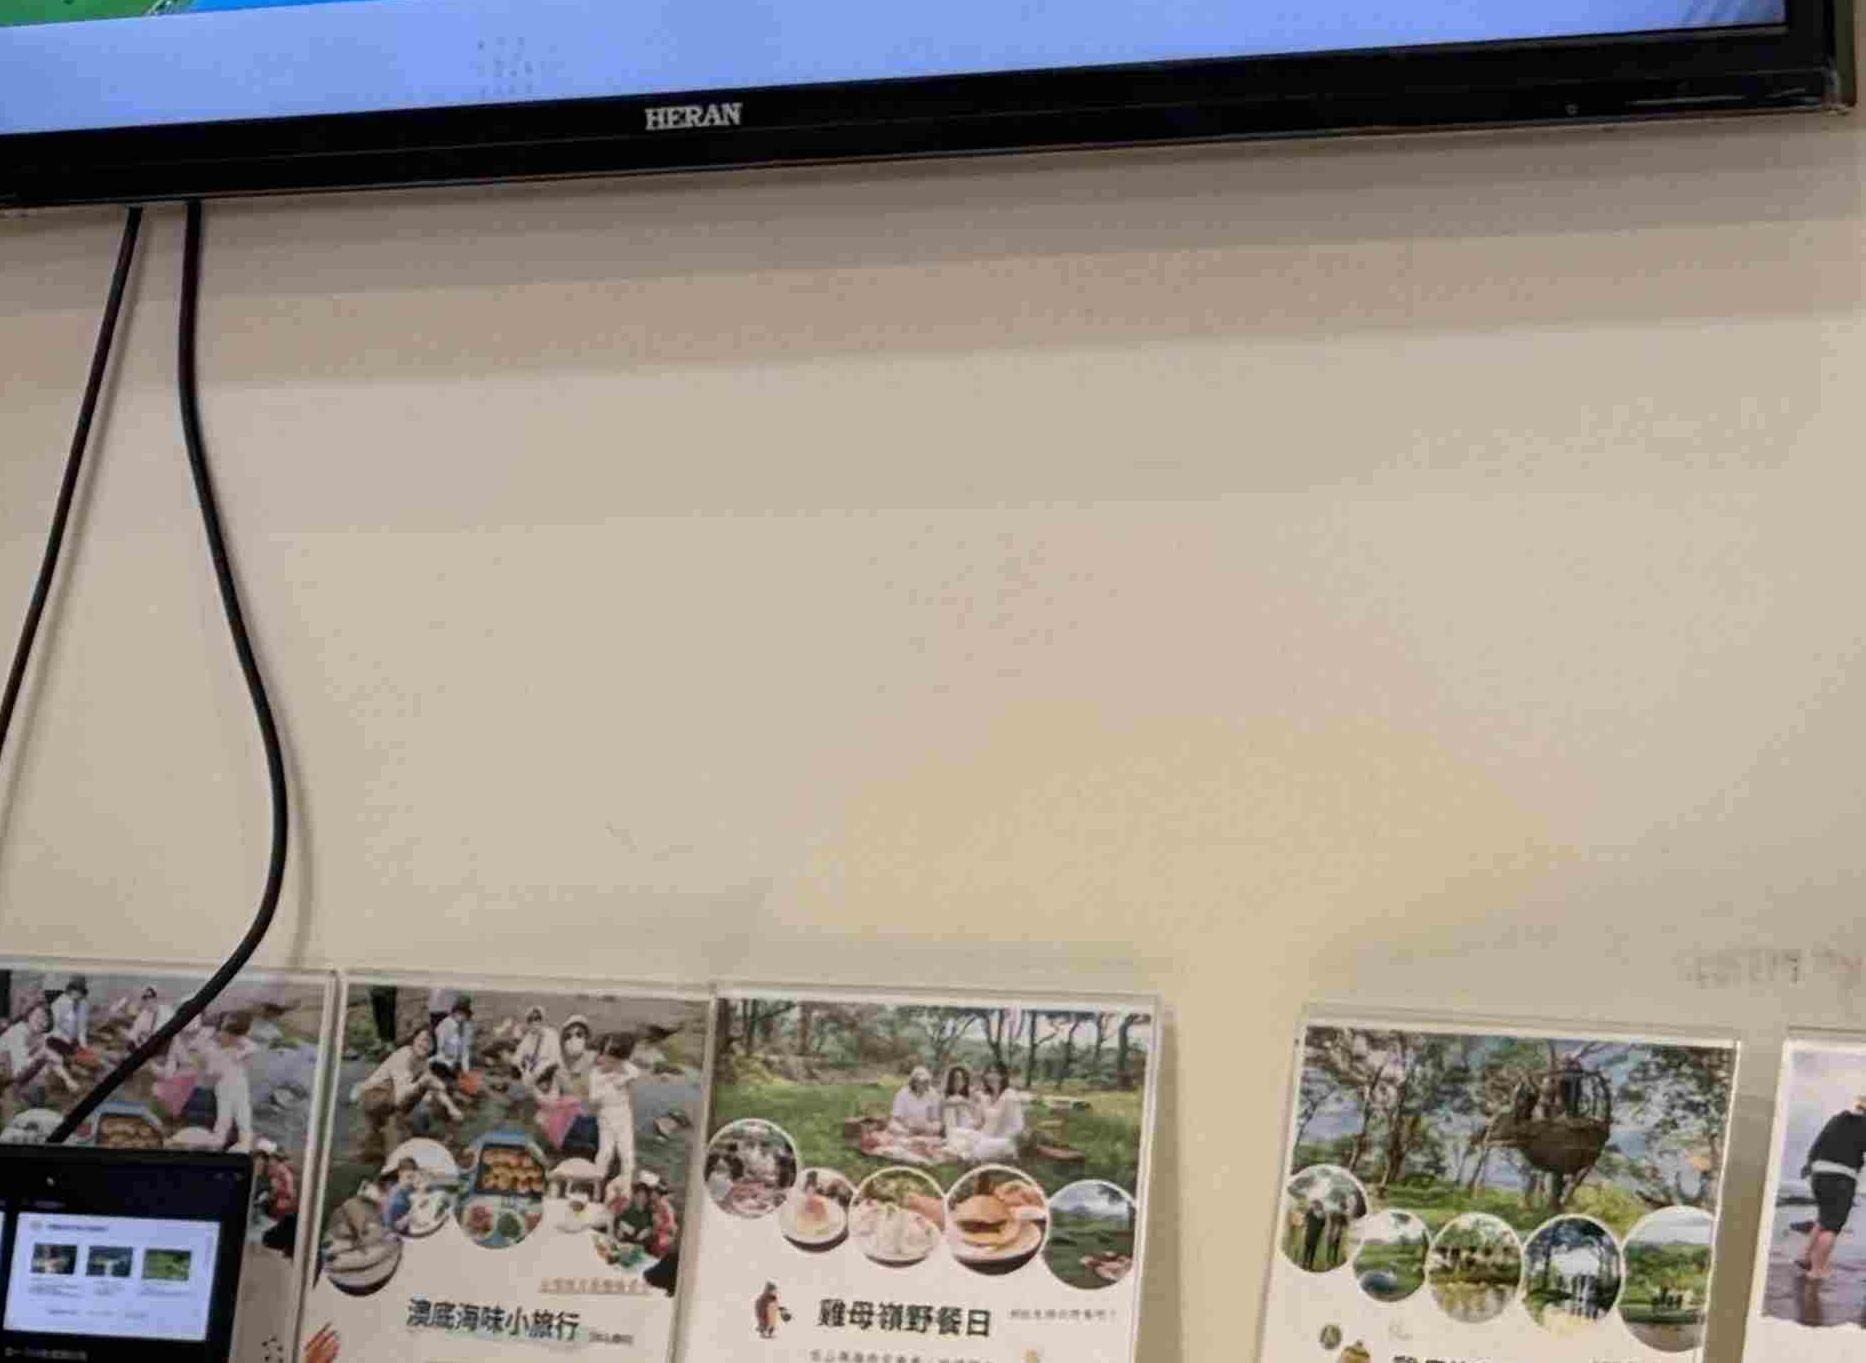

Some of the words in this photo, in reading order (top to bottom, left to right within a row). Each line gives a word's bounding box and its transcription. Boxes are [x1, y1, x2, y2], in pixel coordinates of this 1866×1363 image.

[645, 101, 742, 131] HERAN
[406, 1298, 580, 1341] 澳底海味小旅行
